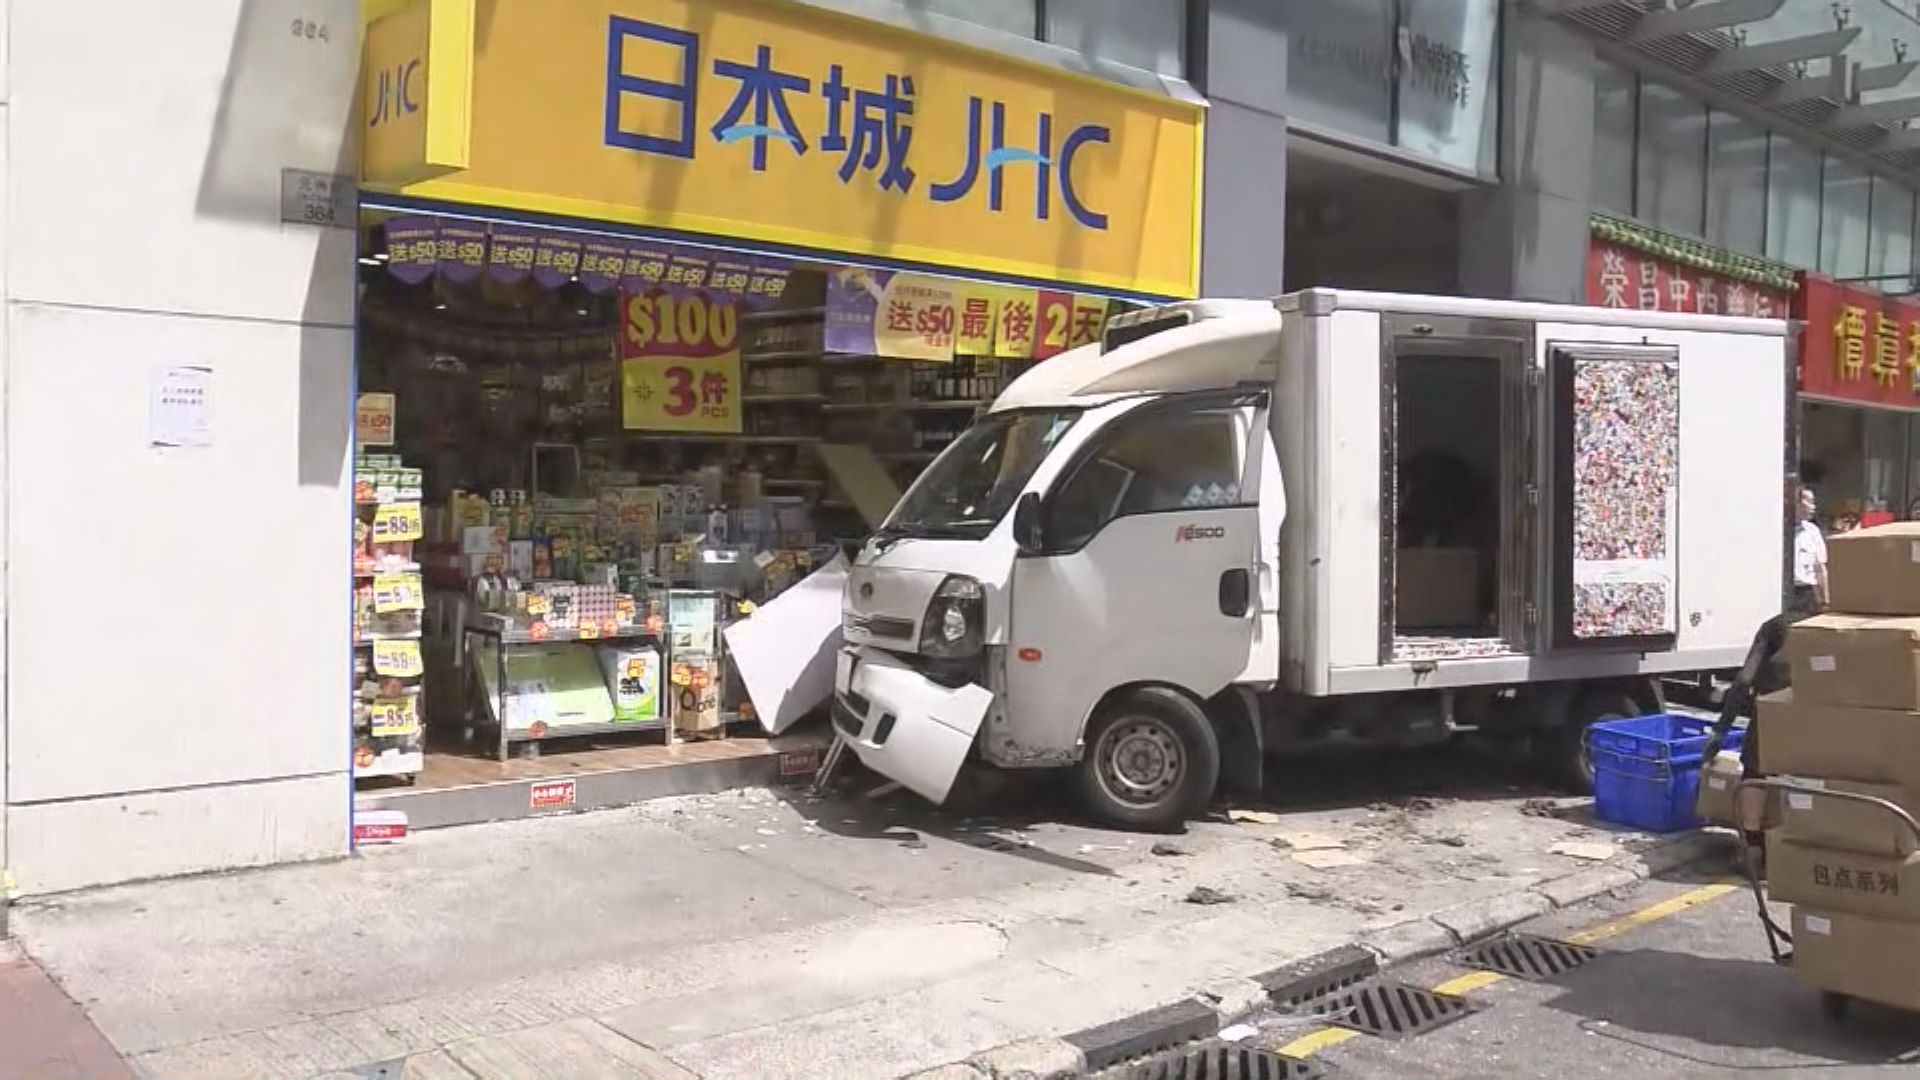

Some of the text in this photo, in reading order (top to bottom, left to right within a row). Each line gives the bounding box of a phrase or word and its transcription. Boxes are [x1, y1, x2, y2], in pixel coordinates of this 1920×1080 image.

[370, 59, 419, 128] JHC
[604, 14, 1110, 231] 日本城 JHC
[627, 292, 737, 349] $100
[1813, 864, 1899, 897] 包点系列
